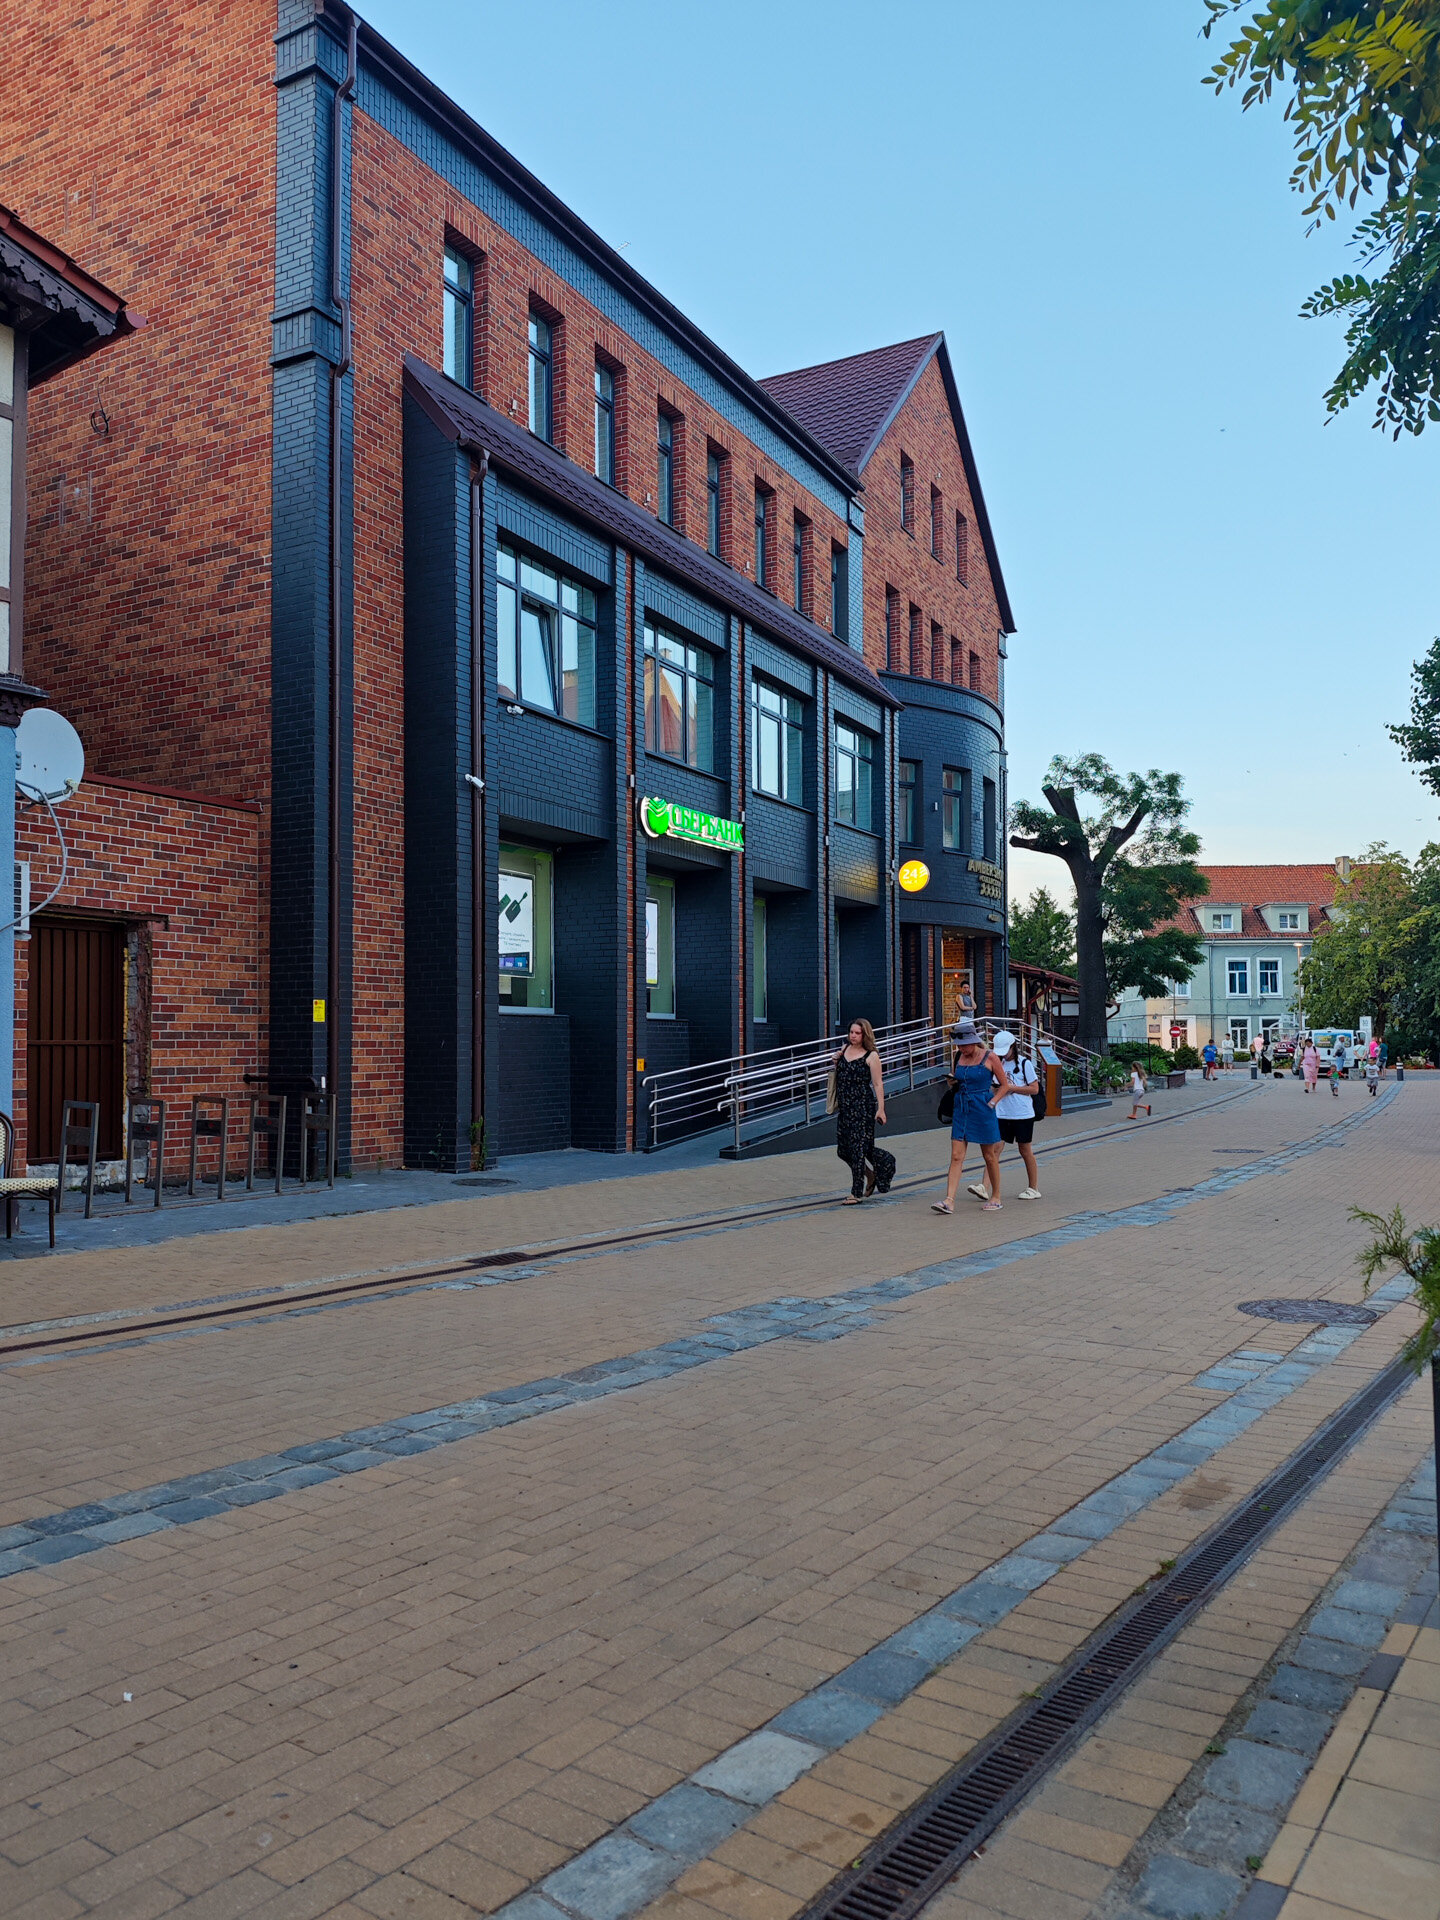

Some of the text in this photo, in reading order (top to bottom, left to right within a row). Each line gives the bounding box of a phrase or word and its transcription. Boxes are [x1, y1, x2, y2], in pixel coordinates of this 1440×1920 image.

[669, 803, 744, 846] СБЕРБАНК
[903, 868, 918, 880] 24
[968, 860, 993, 876] AMBER
